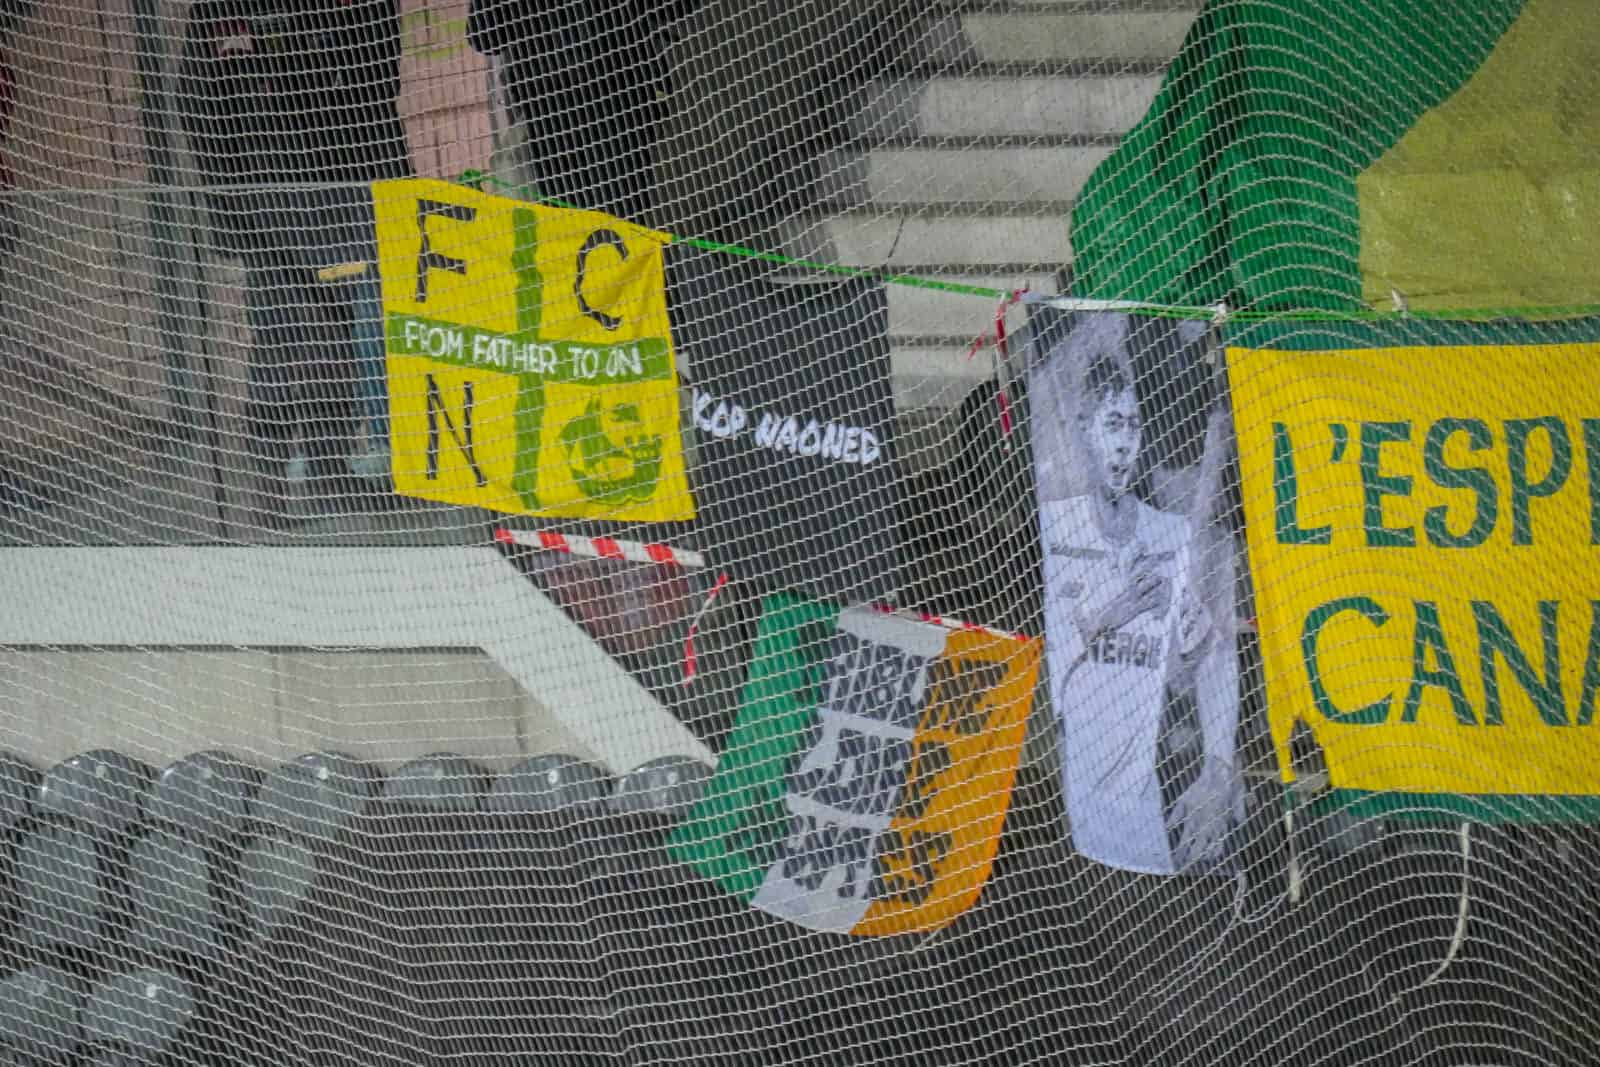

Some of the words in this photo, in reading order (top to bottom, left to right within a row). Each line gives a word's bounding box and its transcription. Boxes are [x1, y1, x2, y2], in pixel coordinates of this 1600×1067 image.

[415, 198, 477, 303] F
[573, 228, 629, 330] C
[404, 319, 464, 359] FROM
[472, 334, 558, 374] FATHER
[567, 345, 600, 379] TO
[426, 372, 488, 488] N
[692, 387, 747, 440] KOP
[754, 411, 881, 465] NAONED
